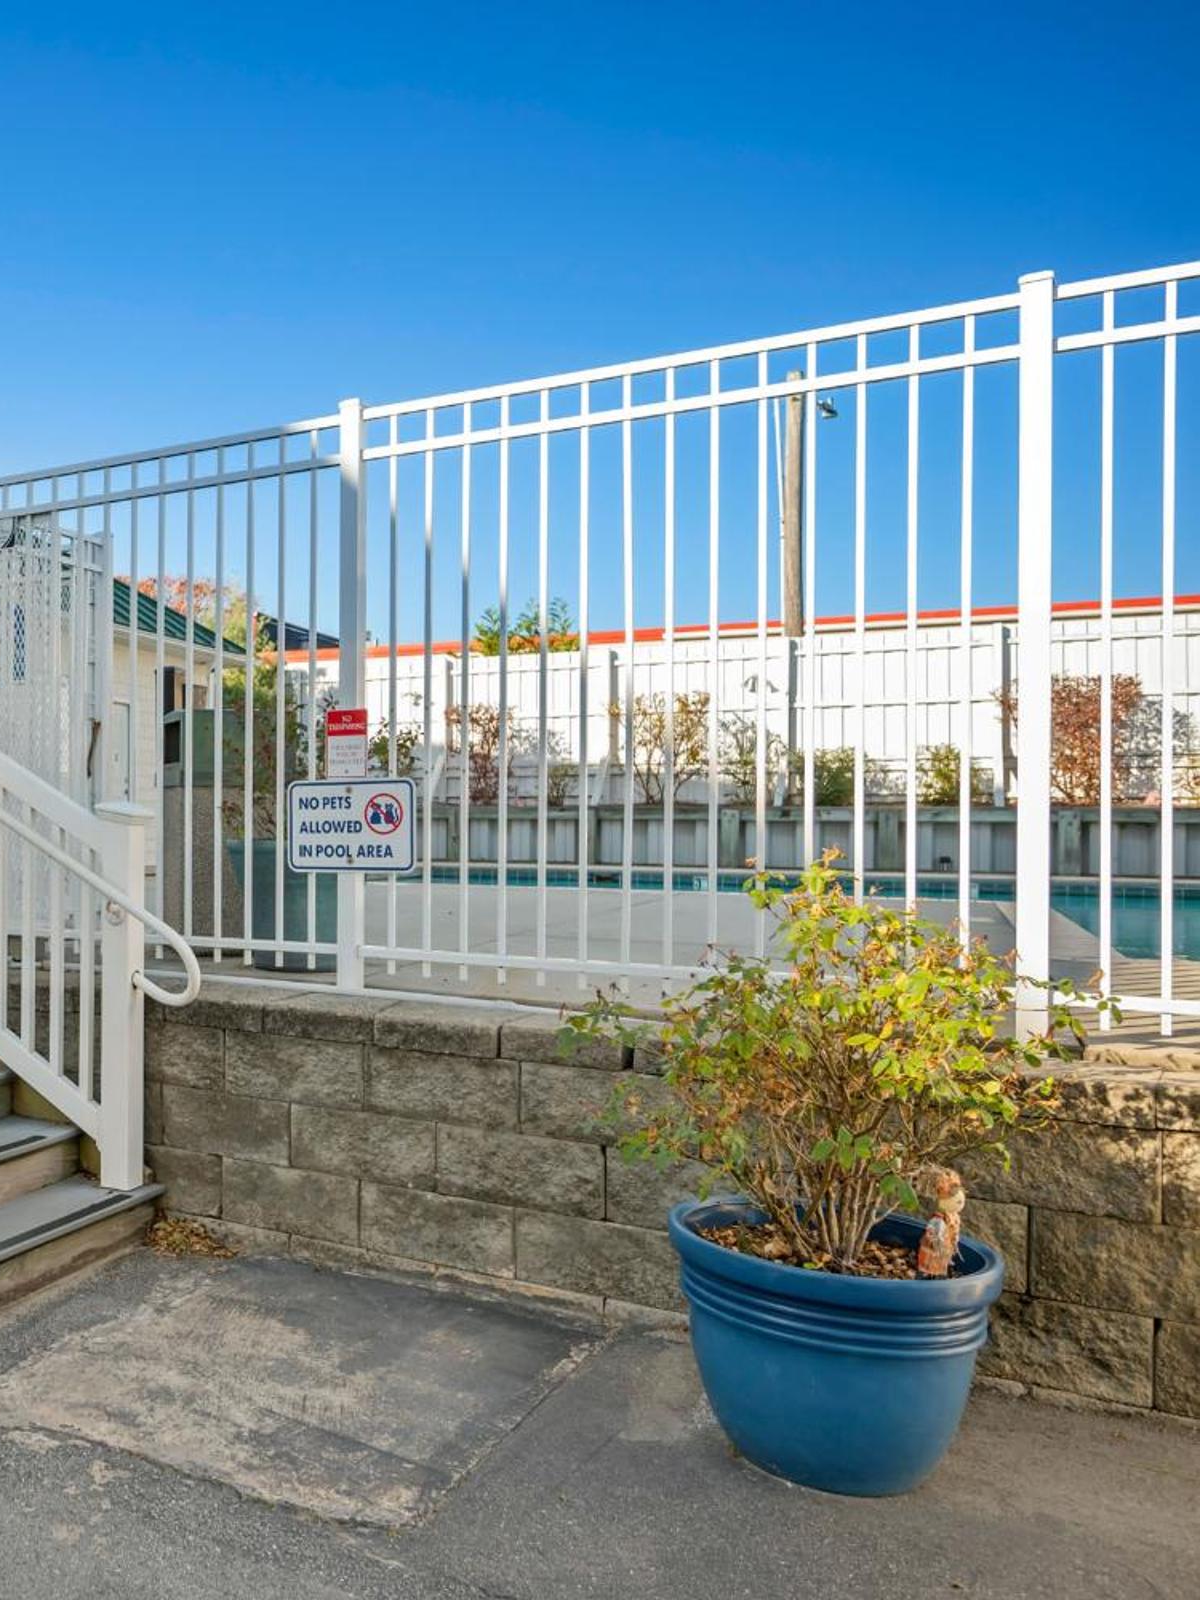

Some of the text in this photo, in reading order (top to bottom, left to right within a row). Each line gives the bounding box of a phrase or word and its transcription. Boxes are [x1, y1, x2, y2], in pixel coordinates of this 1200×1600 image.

[298, 796, 352, 810] NO PETS
[300, 820, 363, 834] ALLOWED
[298, 844, 394, 858] IN POOL AREA
